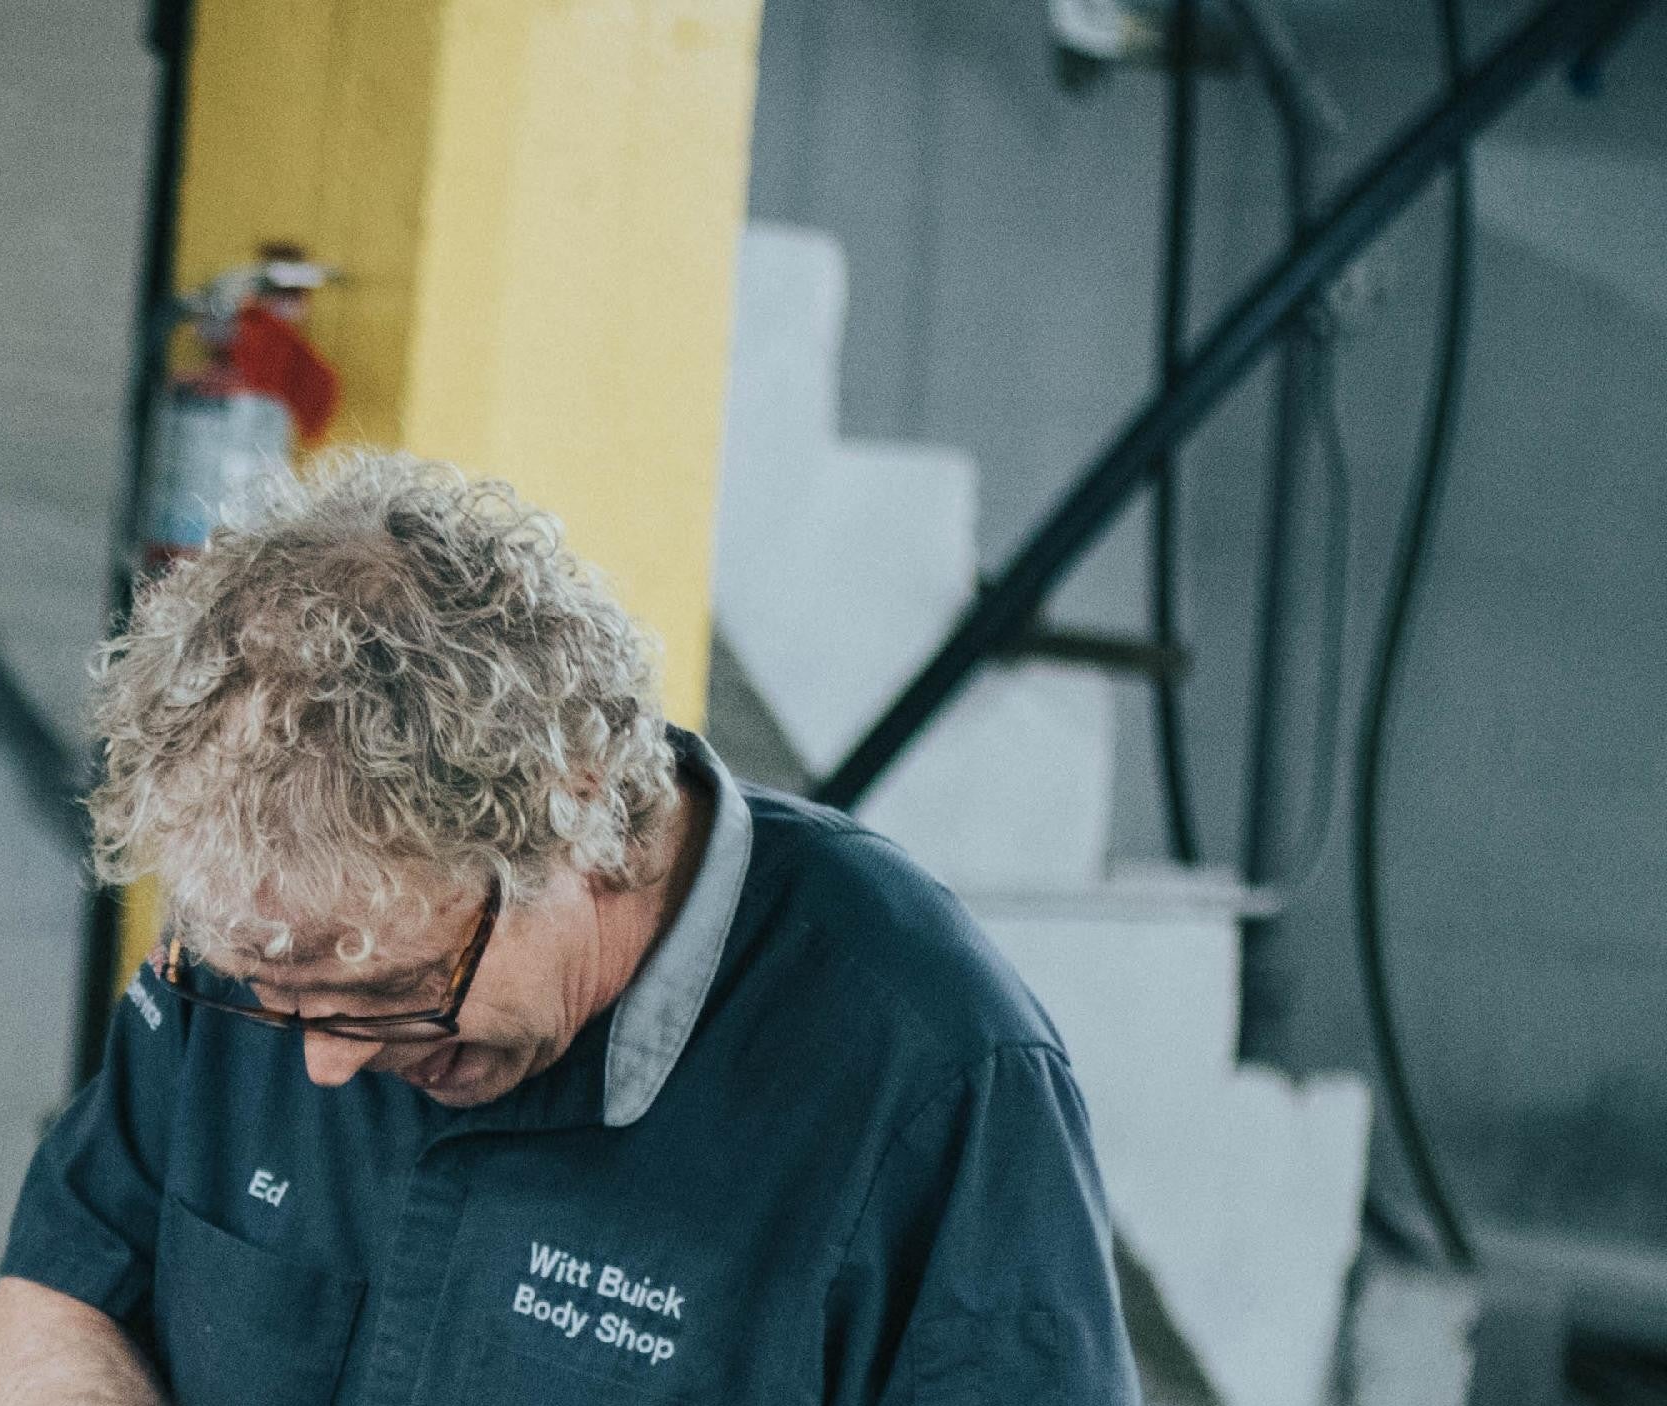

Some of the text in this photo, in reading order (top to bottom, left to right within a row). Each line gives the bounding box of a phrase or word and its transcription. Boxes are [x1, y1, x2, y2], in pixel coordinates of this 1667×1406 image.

[248, 1169, 291, 1207] Ed
[529, 1241, 685, 1320] Witt Buick
[513, 1282, 676, 1366] Body Shop
